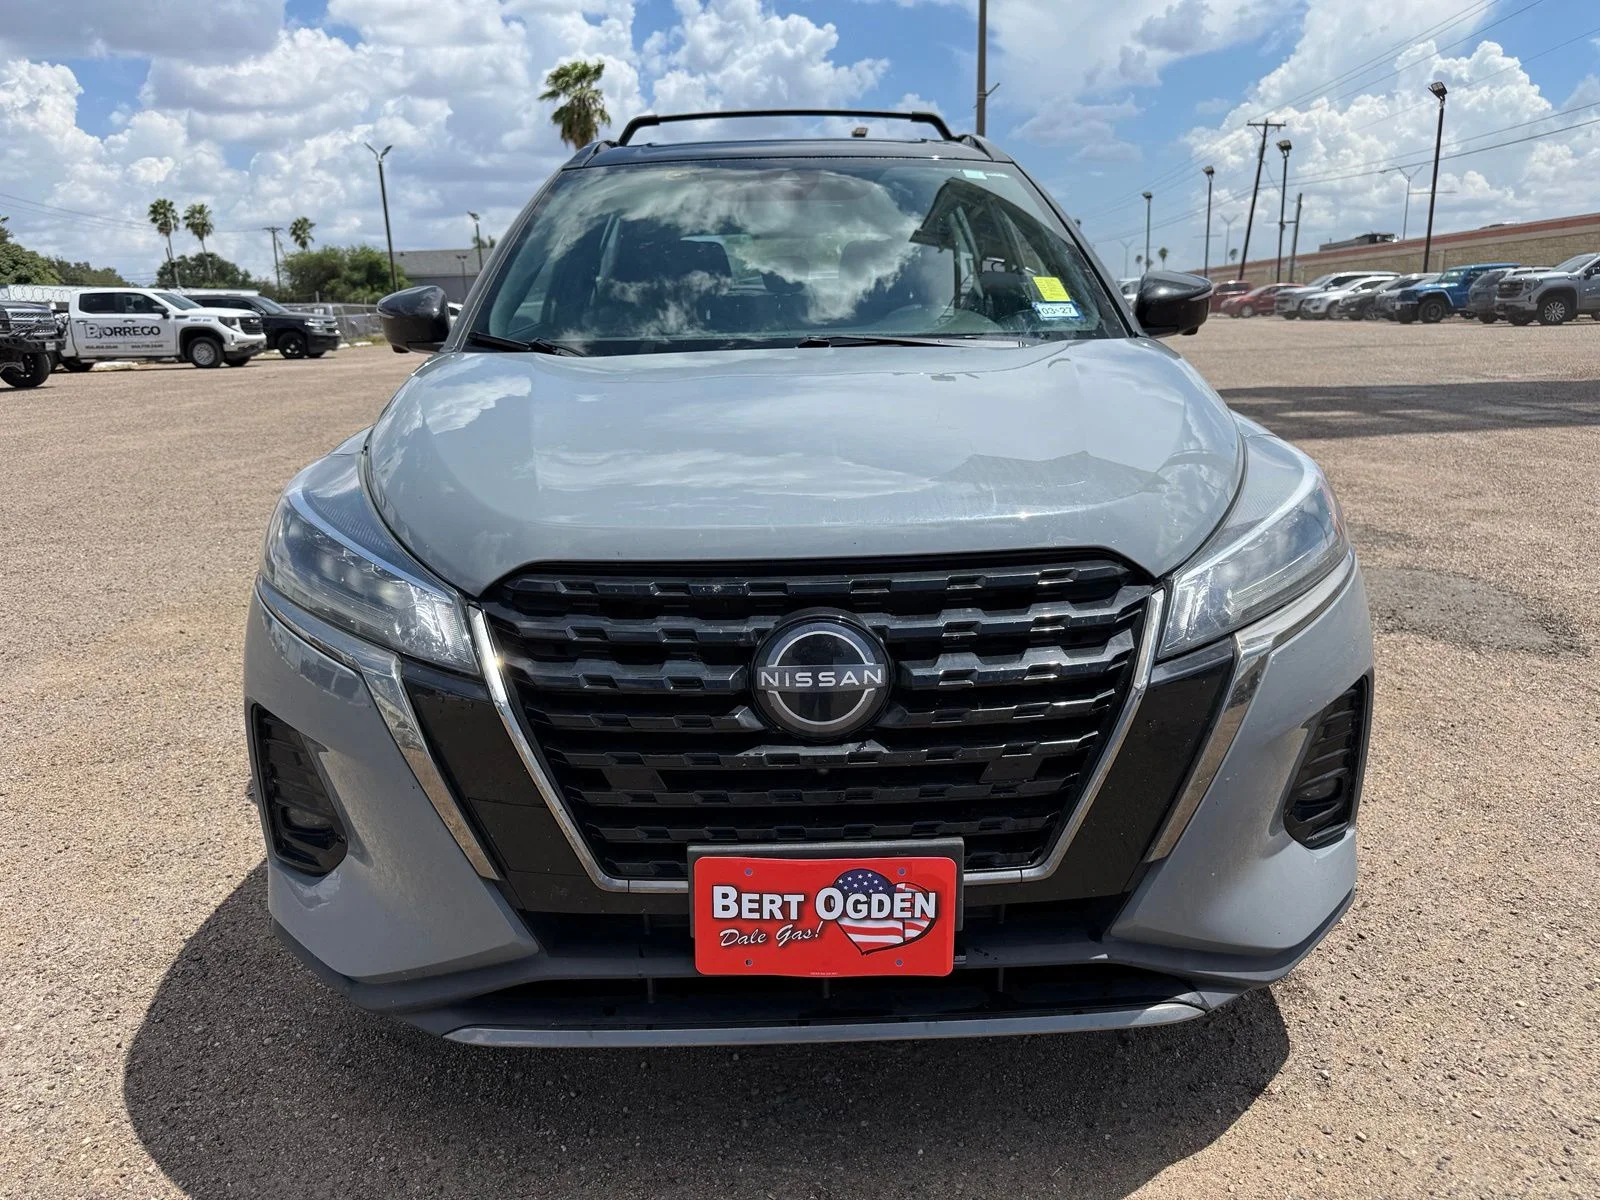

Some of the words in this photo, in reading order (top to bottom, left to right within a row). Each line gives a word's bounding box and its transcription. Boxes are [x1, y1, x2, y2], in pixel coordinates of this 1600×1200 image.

[761, 668, 883, 688] NISSAN
[712, 887, 804, 920] BERT
[815, 887, 936, 920] OGDEN
[719, 928, 767, 946] Dale
[774, 921, 822, 947] Gas!
